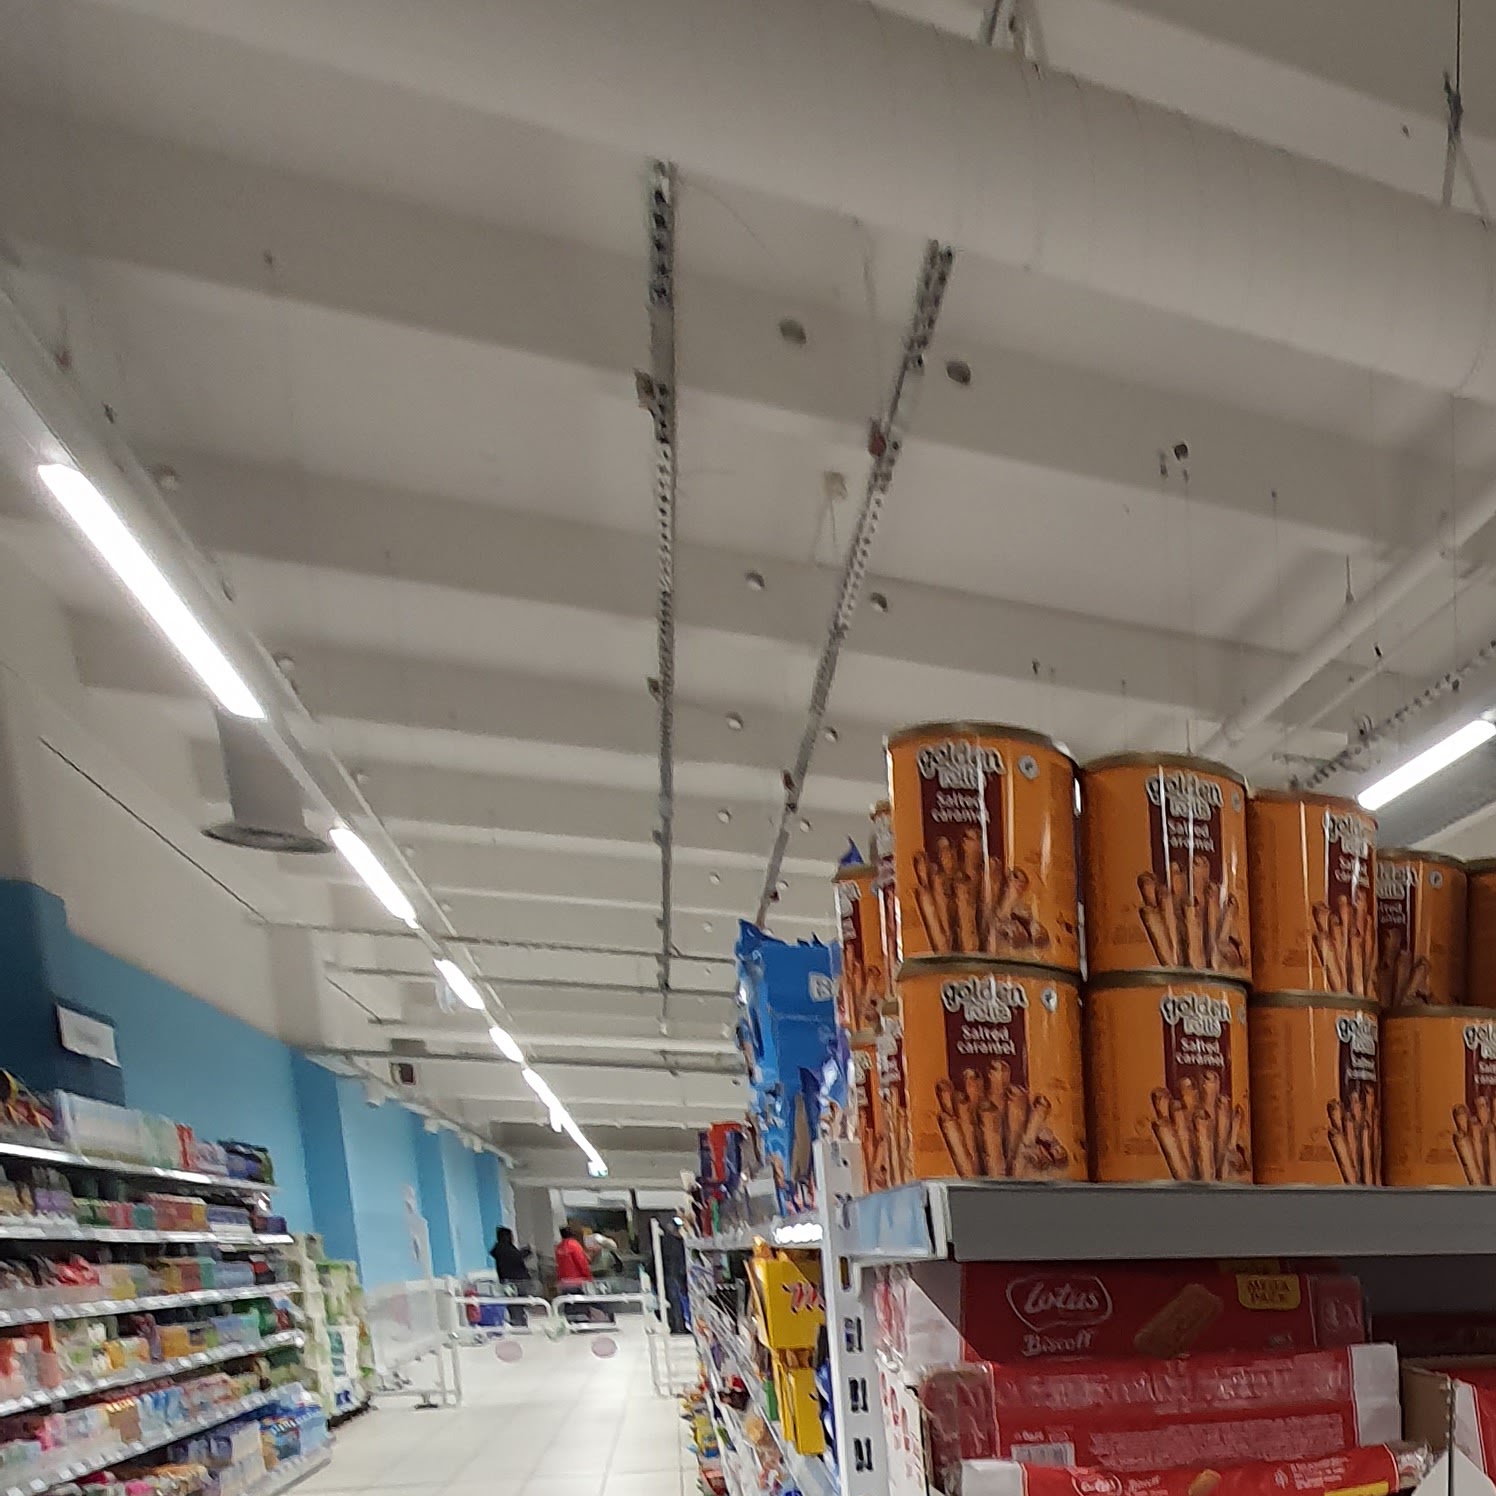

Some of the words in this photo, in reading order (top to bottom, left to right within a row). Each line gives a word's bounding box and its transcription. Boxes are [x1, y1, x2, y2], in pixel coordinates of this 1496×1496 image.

[942, 973, 1029, 1012] golden
[1160, 990, 1232, 1025] golden
[1024, 1280, 1101, 1316] Lotus
[1021, 1325, 1097, 1357] Biscoff
